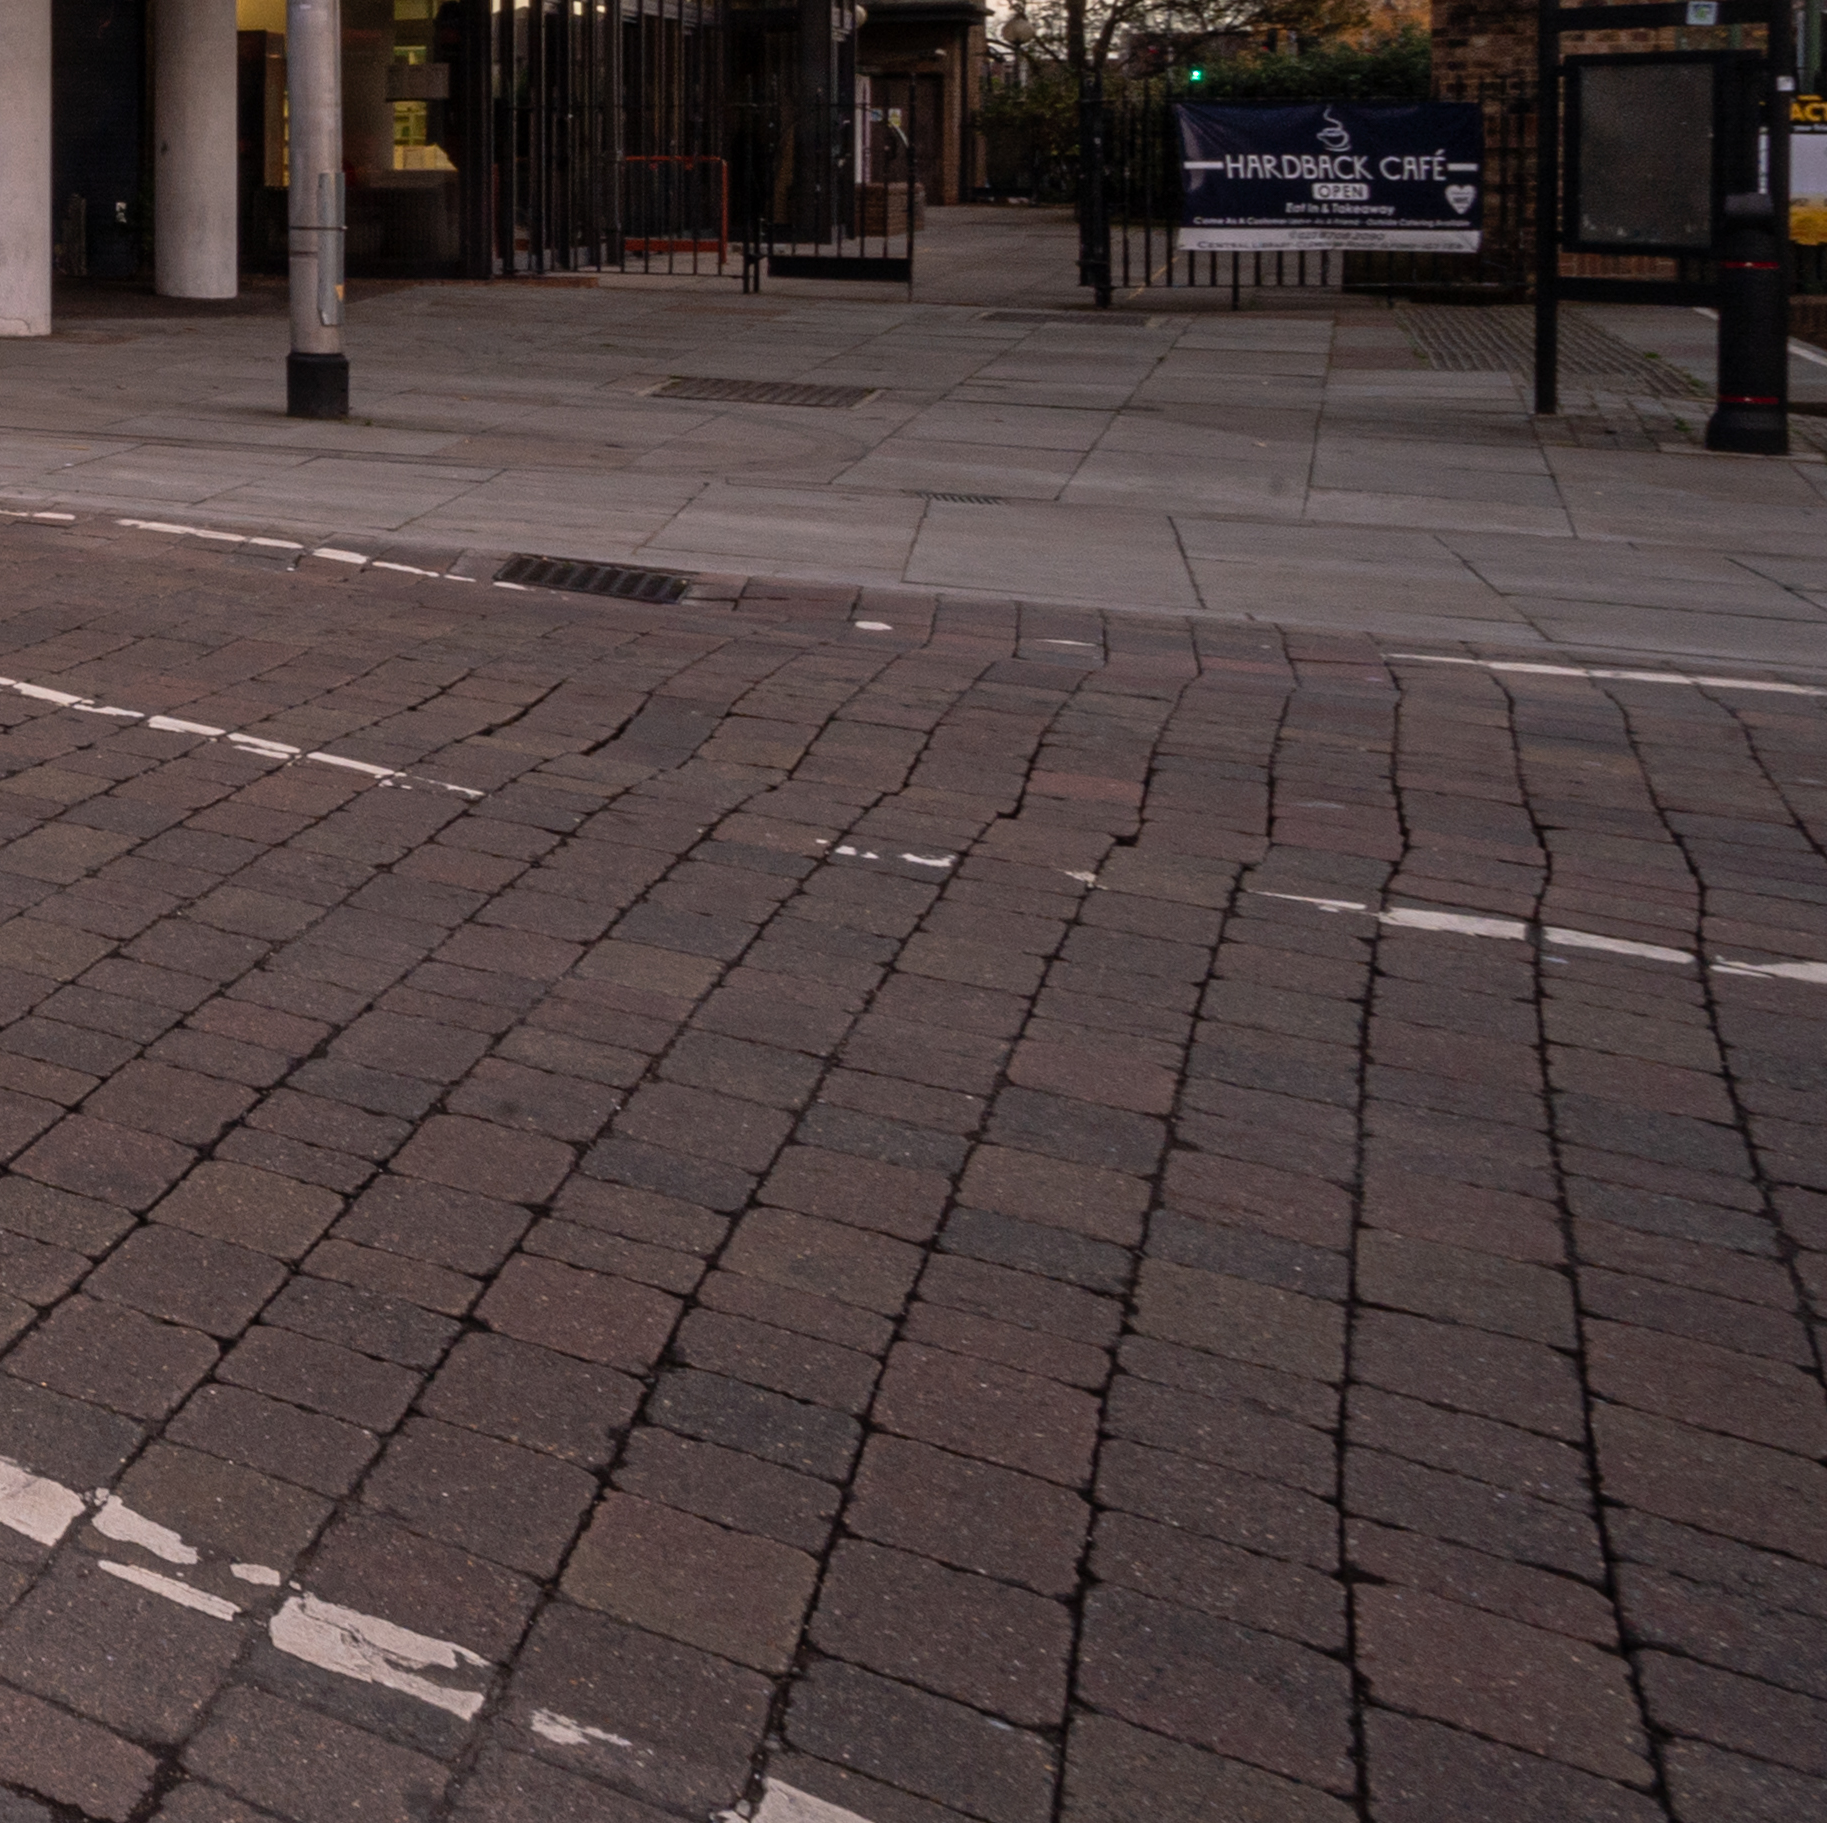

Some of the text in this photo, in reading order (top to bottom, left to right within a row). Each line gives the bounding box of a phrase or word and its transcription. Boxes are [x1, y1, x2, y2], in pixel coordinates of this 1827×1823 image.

[1224, 148, 1448, 181] HARDBACK CAFÉ
[1317, 185, 1364, 199] OPEN
[1285, 202, 1306, 214] Eat
[1321, 202, 1330, 214] &
[1331, 203, 1395, 216] Takeaway
